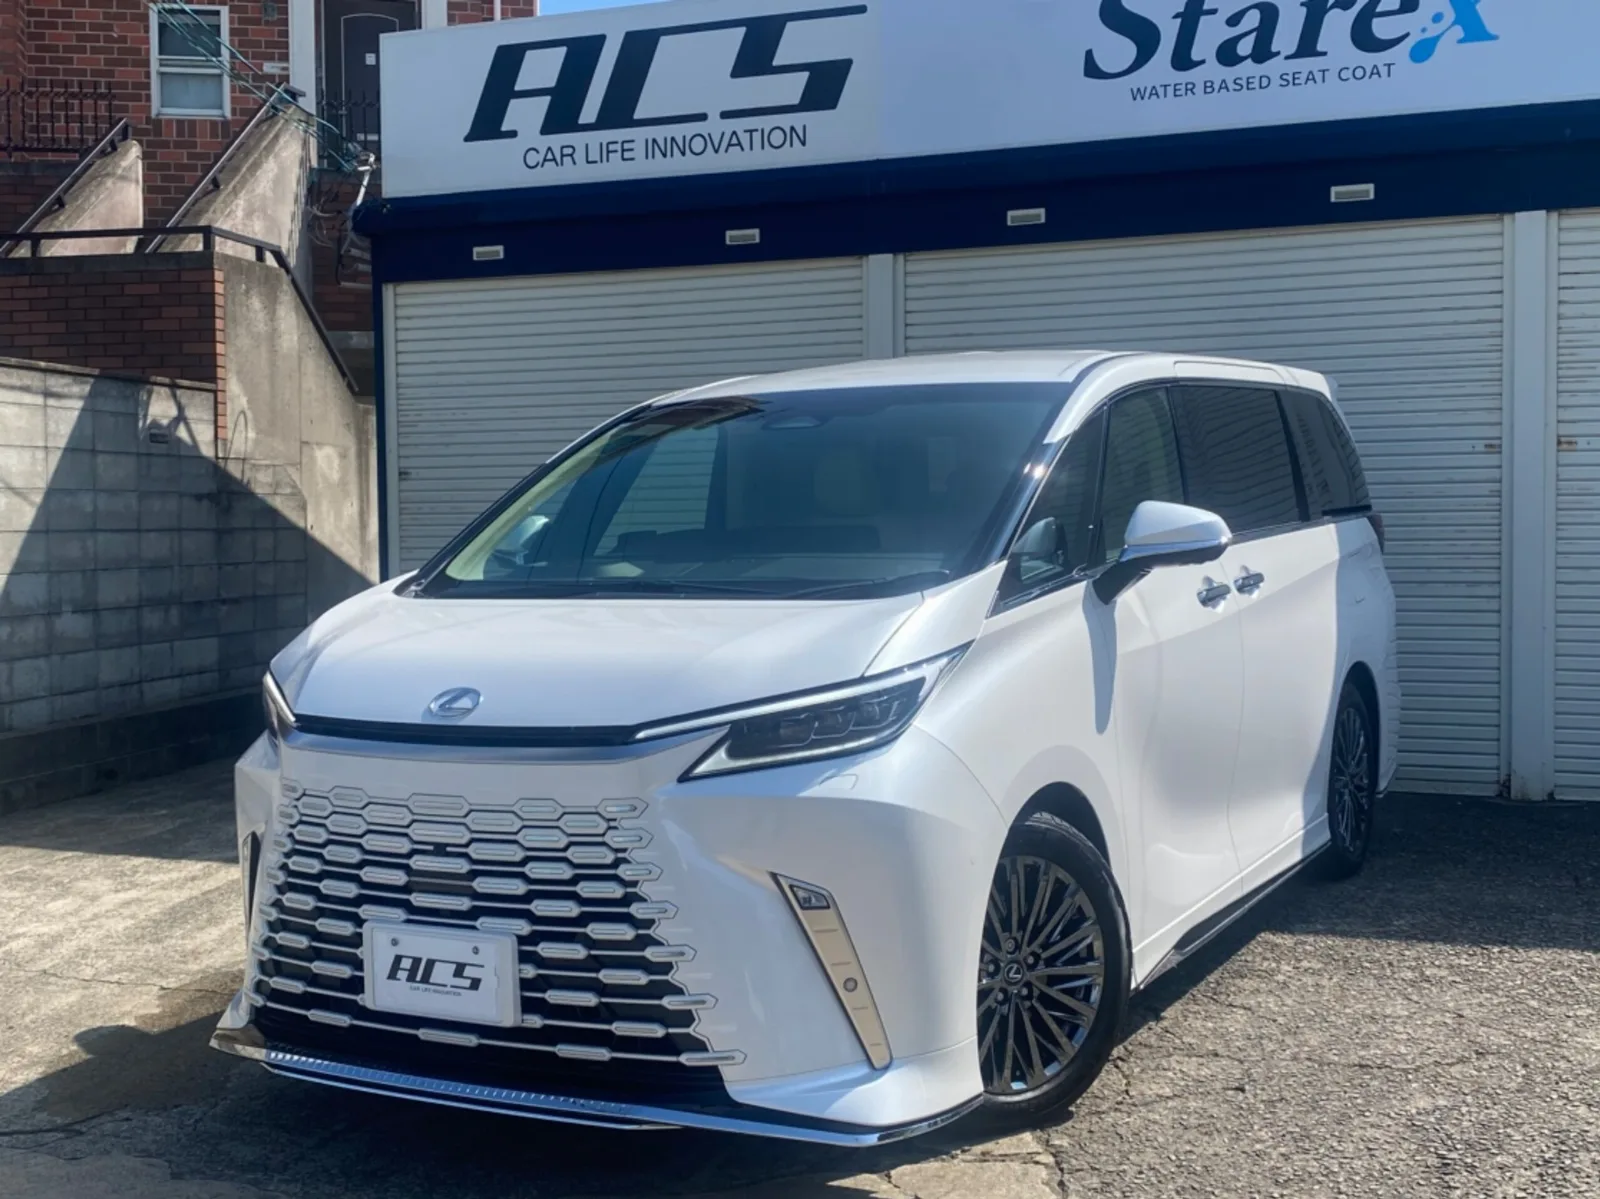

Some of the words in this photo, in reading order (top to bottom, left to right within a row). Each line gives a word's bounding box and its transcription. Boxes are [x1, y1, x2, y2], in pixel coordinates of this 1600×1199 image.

[463, 4, 868, 142] ACS
[1130, 82, 1197, 102] WATER
[1203, 75, 1272, 95] BASED
[1278, 69, 1330, 88] SEAT
[1337, 63, 1396, 82] COAT
[523, 144, 577, 170] CAR
[585, 139, 636, 165] LIFE
[644, 124, 807, 160] INNOVATION
[386, 954, 485, 991] ACS
